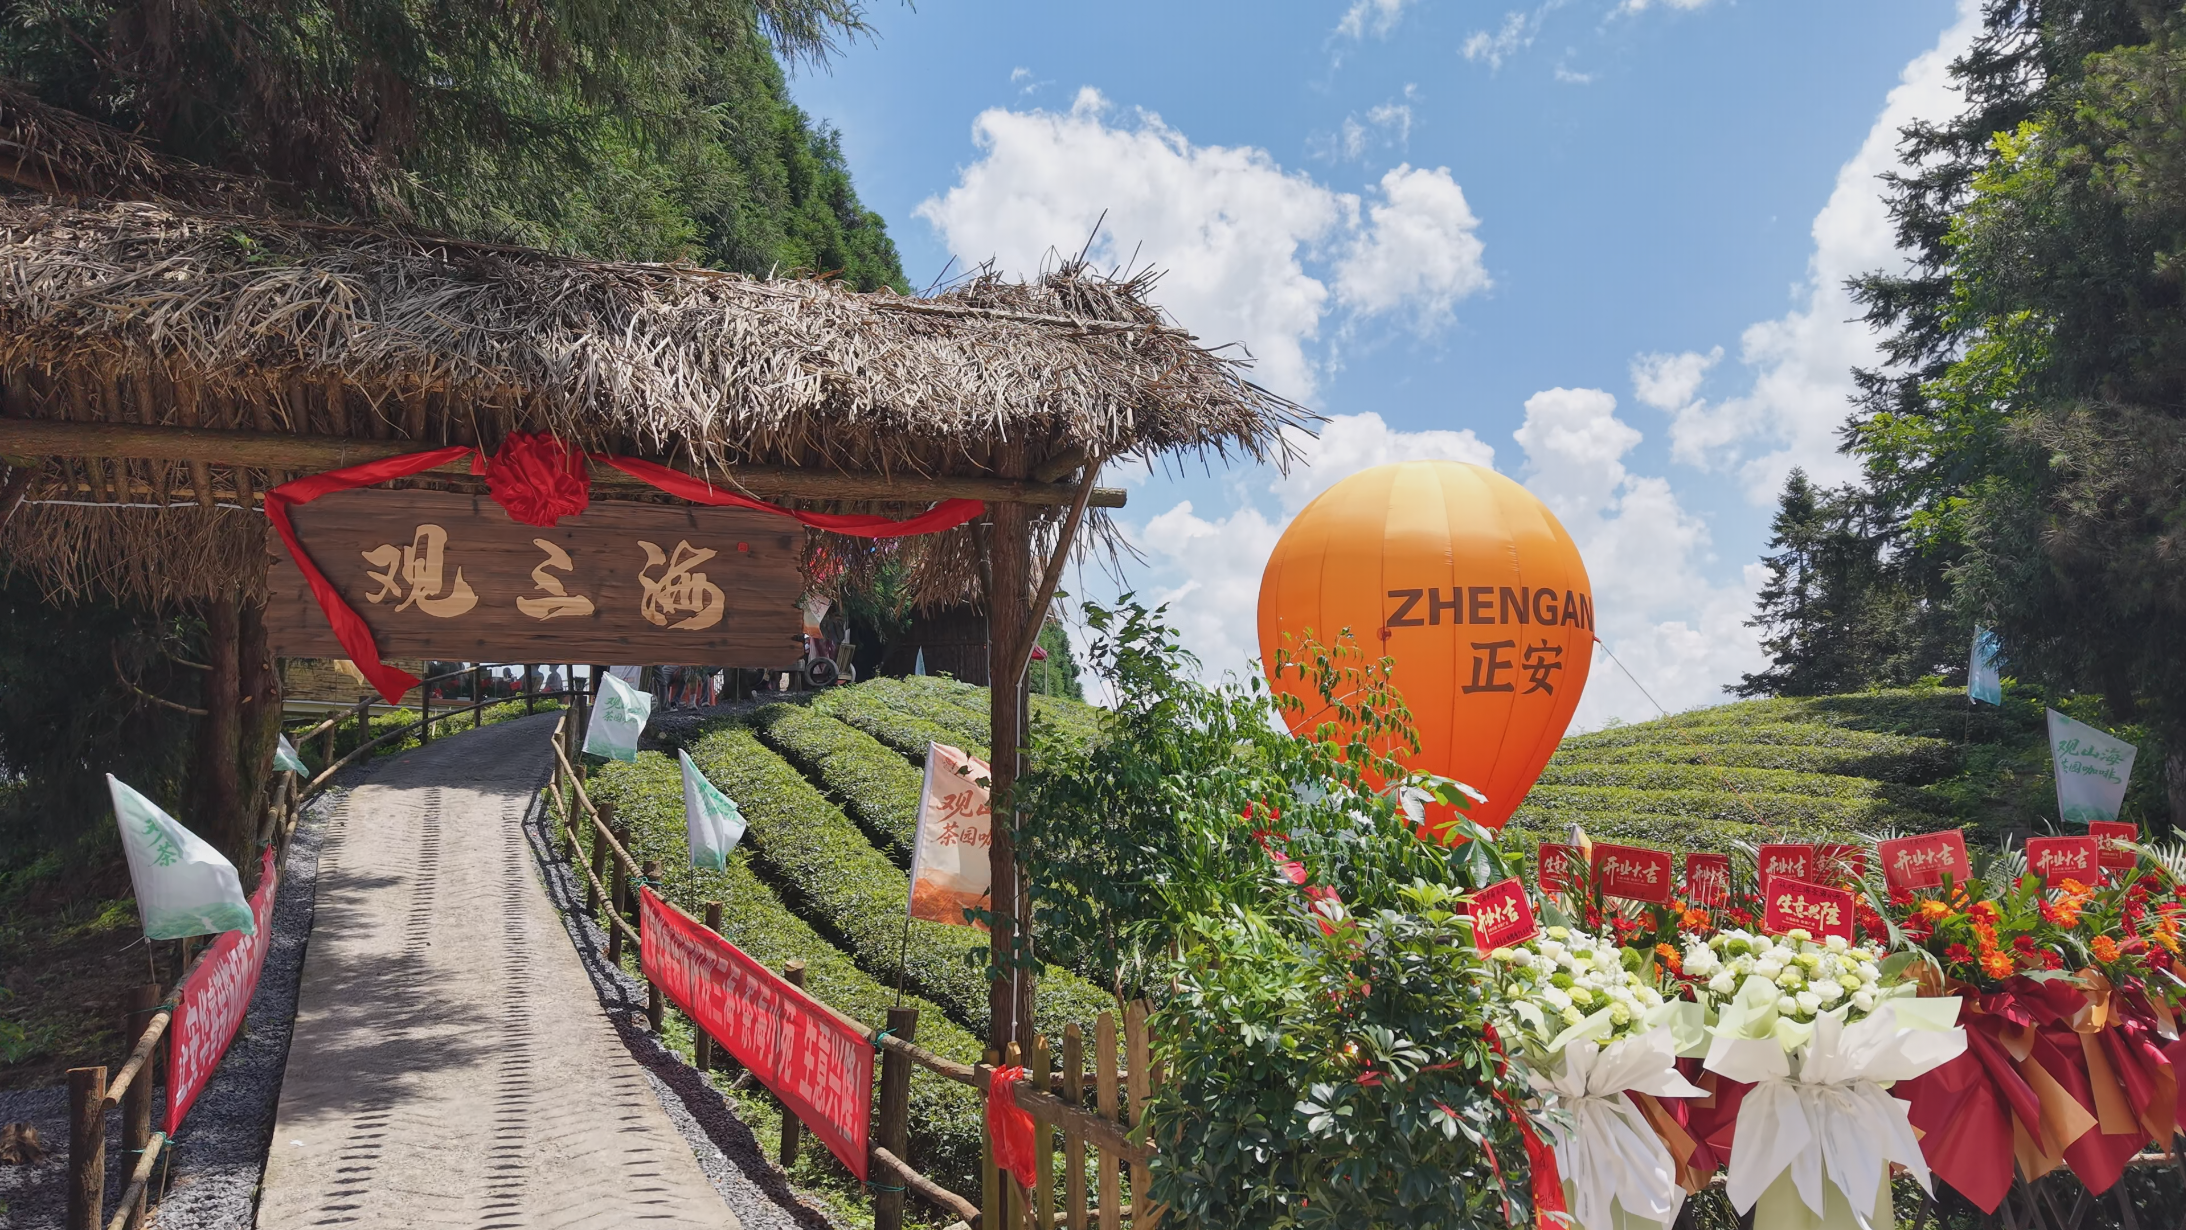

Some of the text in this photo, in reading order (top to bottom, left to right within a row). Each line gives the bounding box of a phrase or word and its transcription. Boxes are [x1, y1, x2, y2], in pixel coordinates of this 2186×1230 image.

[1386, 586, 1594, 632] ZHENGAN
[1461, 639, 1563, 696] 正安
[1602, 855, 1662, 886] 开业大吉
[1893, 842, 1955, 879] 开业大吉
[2036, 846, 2090, 879] 开业大吉
[1775, 892, 1842, 932] 生意兴隆
